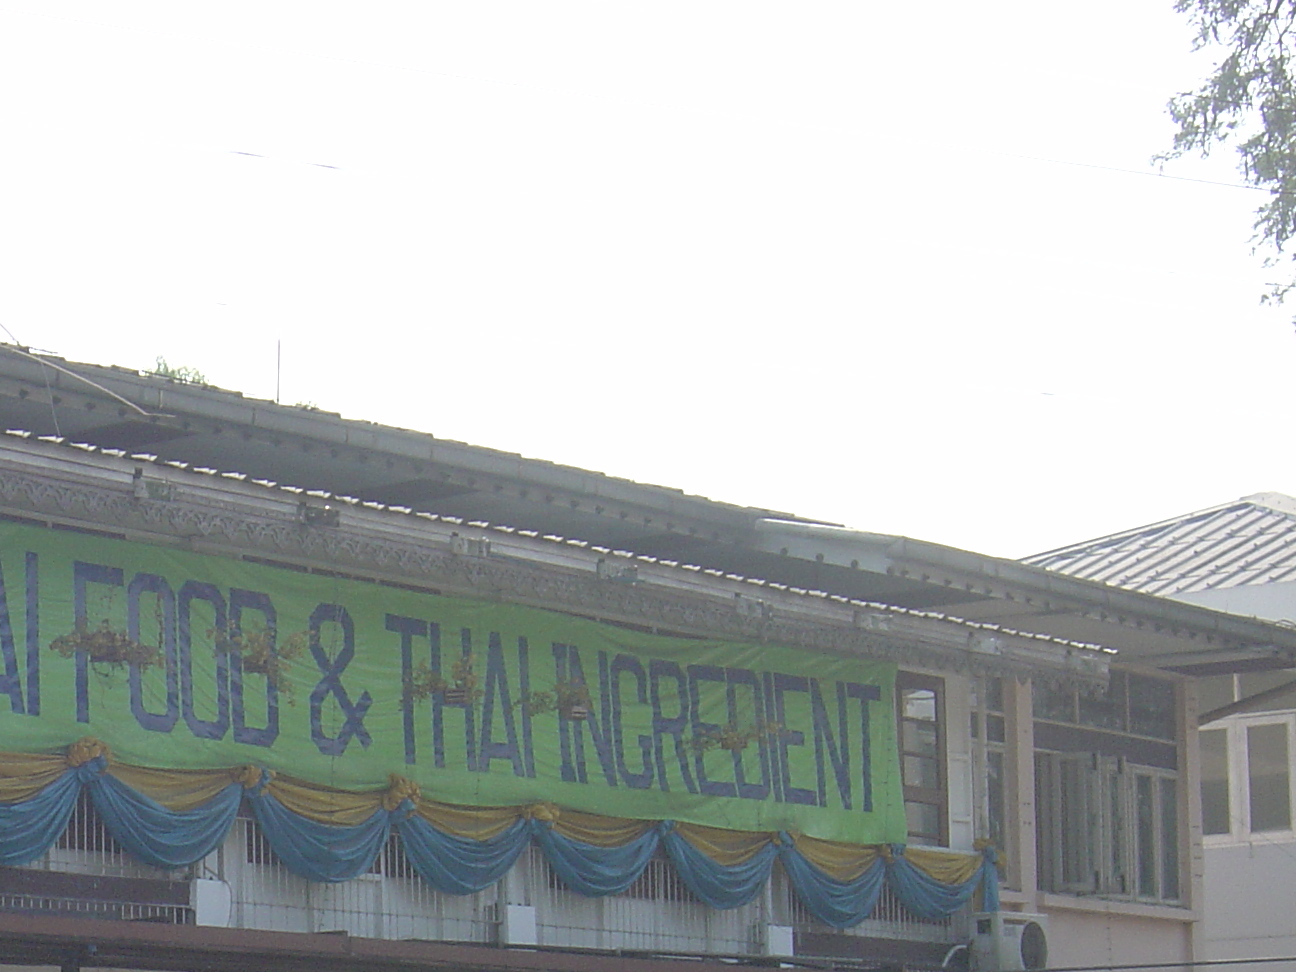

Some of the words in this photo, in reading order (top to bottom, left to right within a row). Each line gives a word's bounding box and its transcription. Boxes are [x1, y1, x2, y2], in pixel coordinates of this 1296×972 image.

[73, 560, 280, 748] FOOD
[309, 602, 373, 757] &
[385, 612, 536, 779] THAI
[551, 642, 882, 813] INGREDIENT
